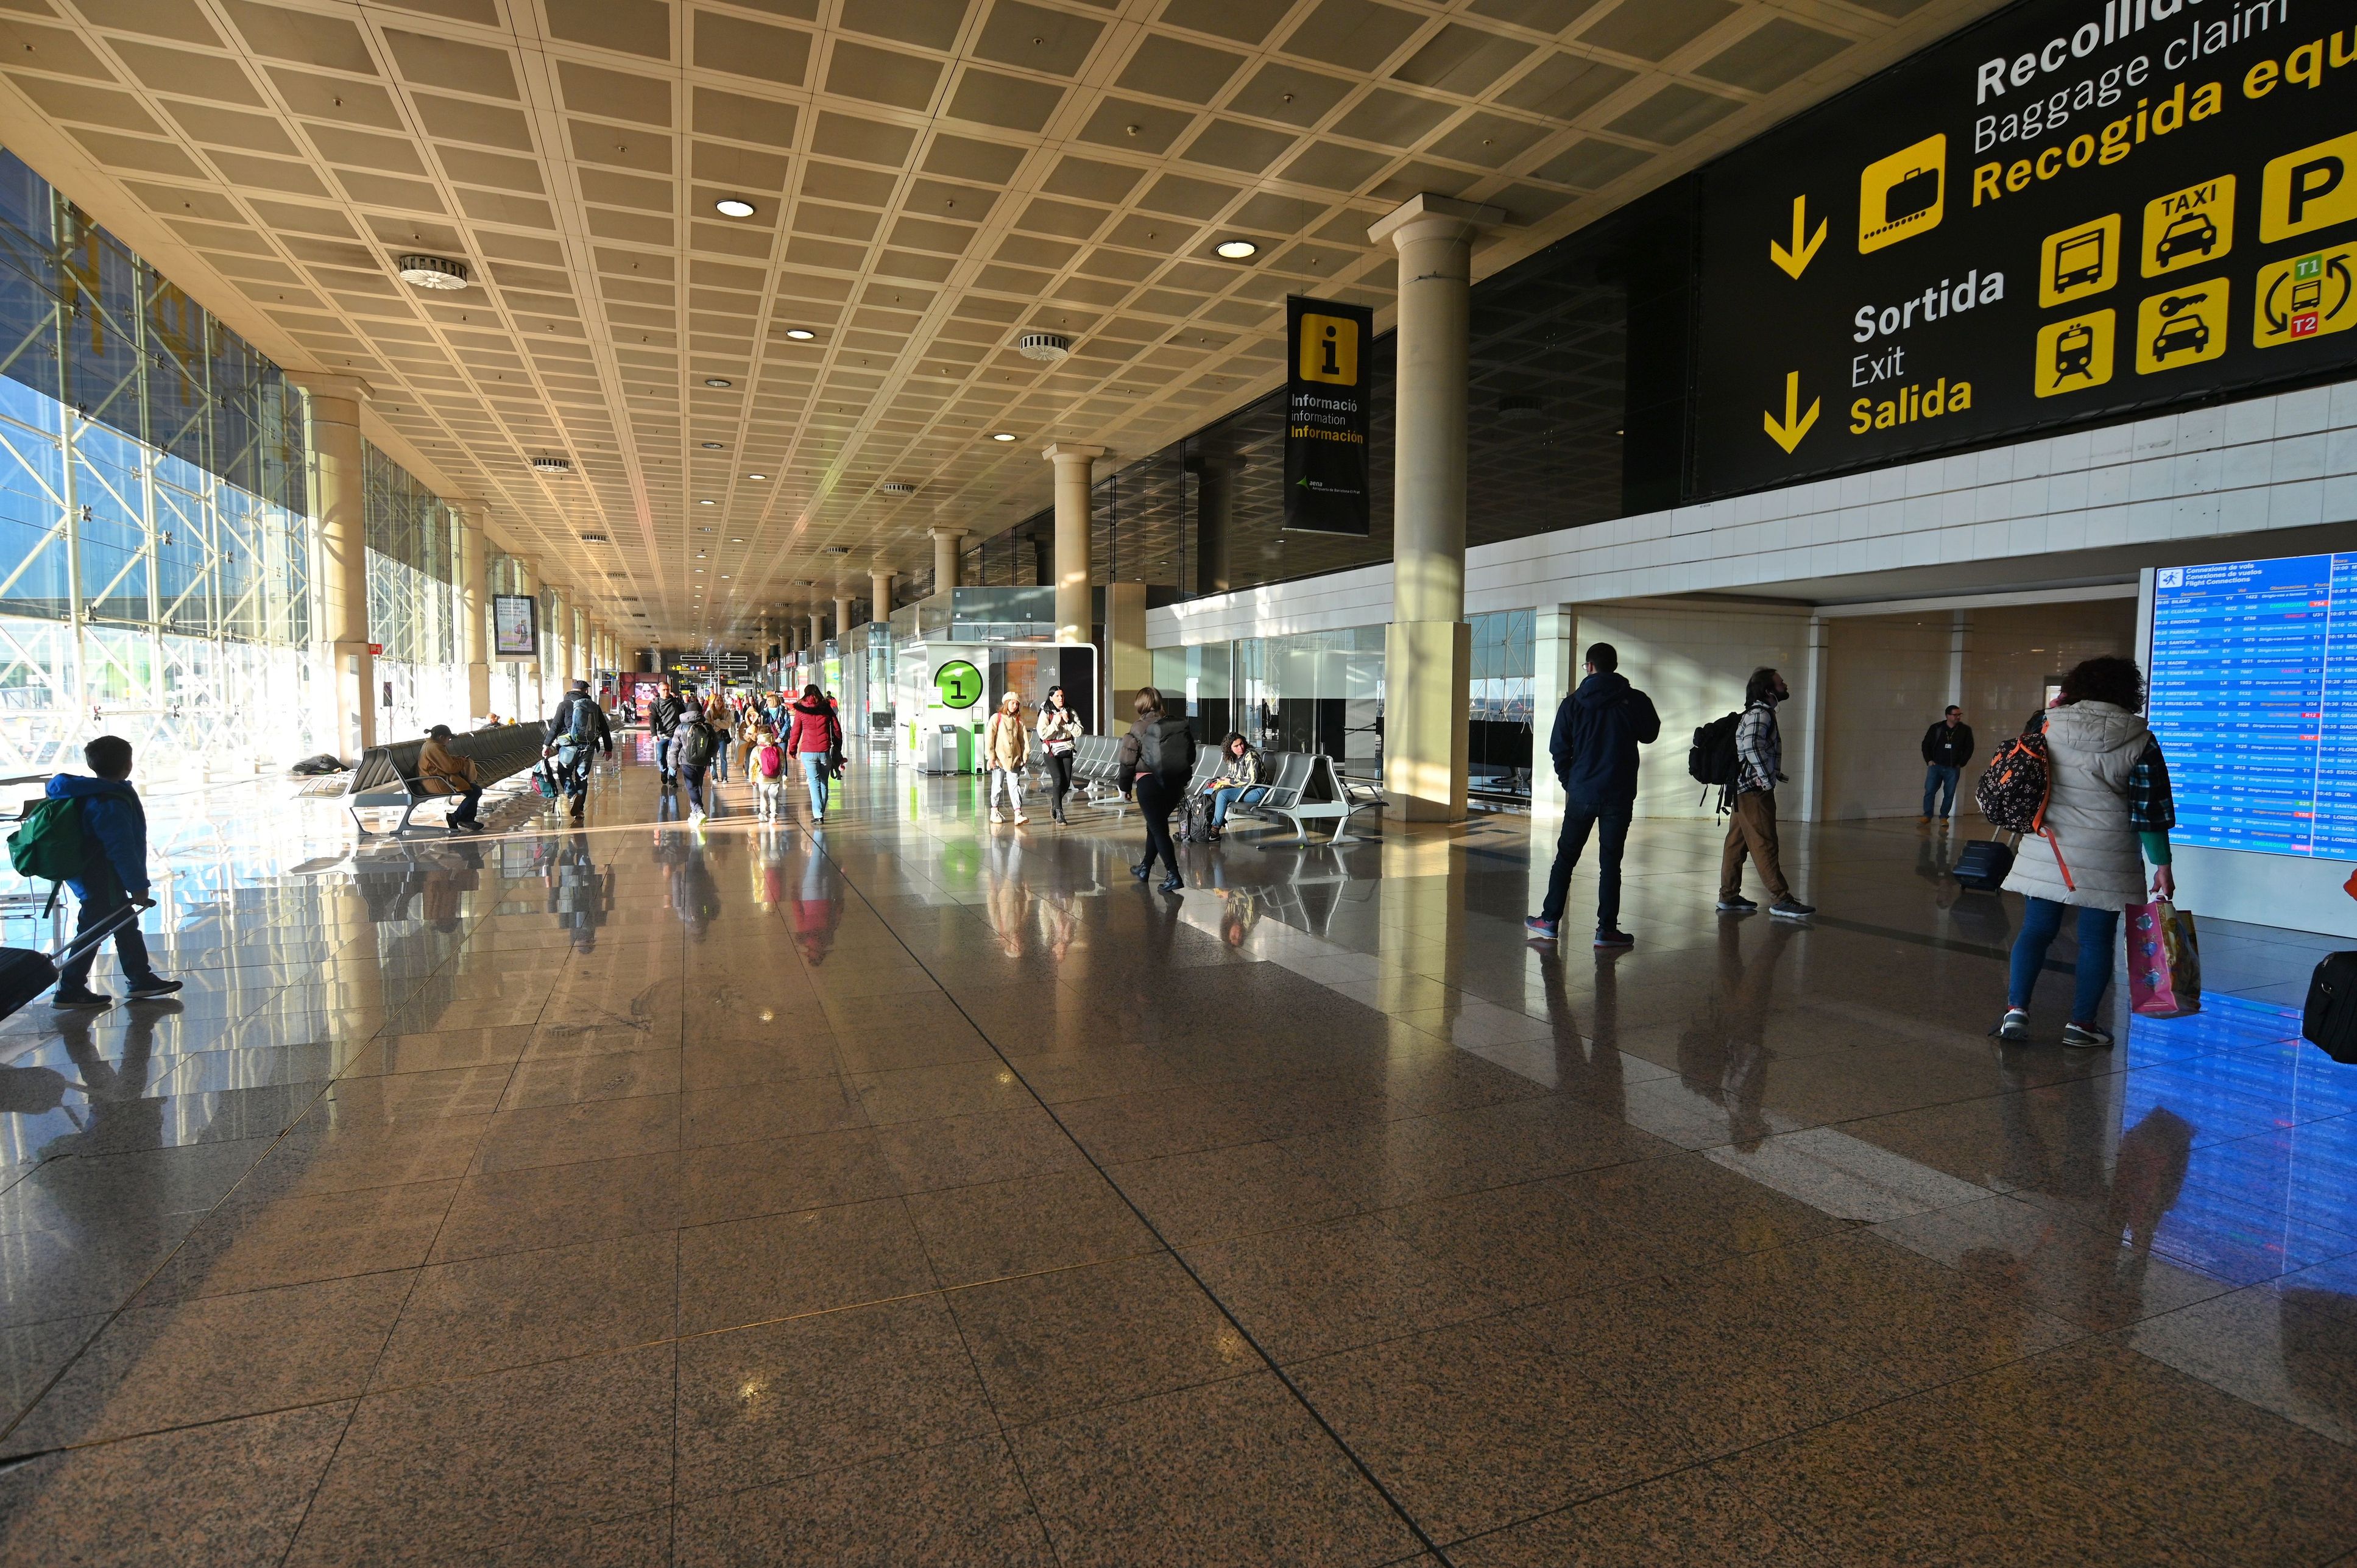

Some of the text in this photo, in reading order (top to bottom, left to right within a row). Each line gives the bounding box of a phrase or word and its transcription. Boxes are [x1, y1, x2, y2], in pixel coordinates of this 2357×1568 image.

[1974, 0, 2287, 154] Baggage claim
[1973, 82, 2222, 208] Recogida
[2161, 184, 2217, 217] TAXI
[2297, 259, 2319, 276] T1
[1853, 269, 2005, 343] Sortida
[2293, 316, 2316, 333] T2
[1852, 345, 1905, 387] Exit
[1291, 409, 1346, 425] information
[1292, 394, 1357, 412] Informació
[1850, 377, 1972, 434] Salida
[1291, 425, 1363, 444] Información
